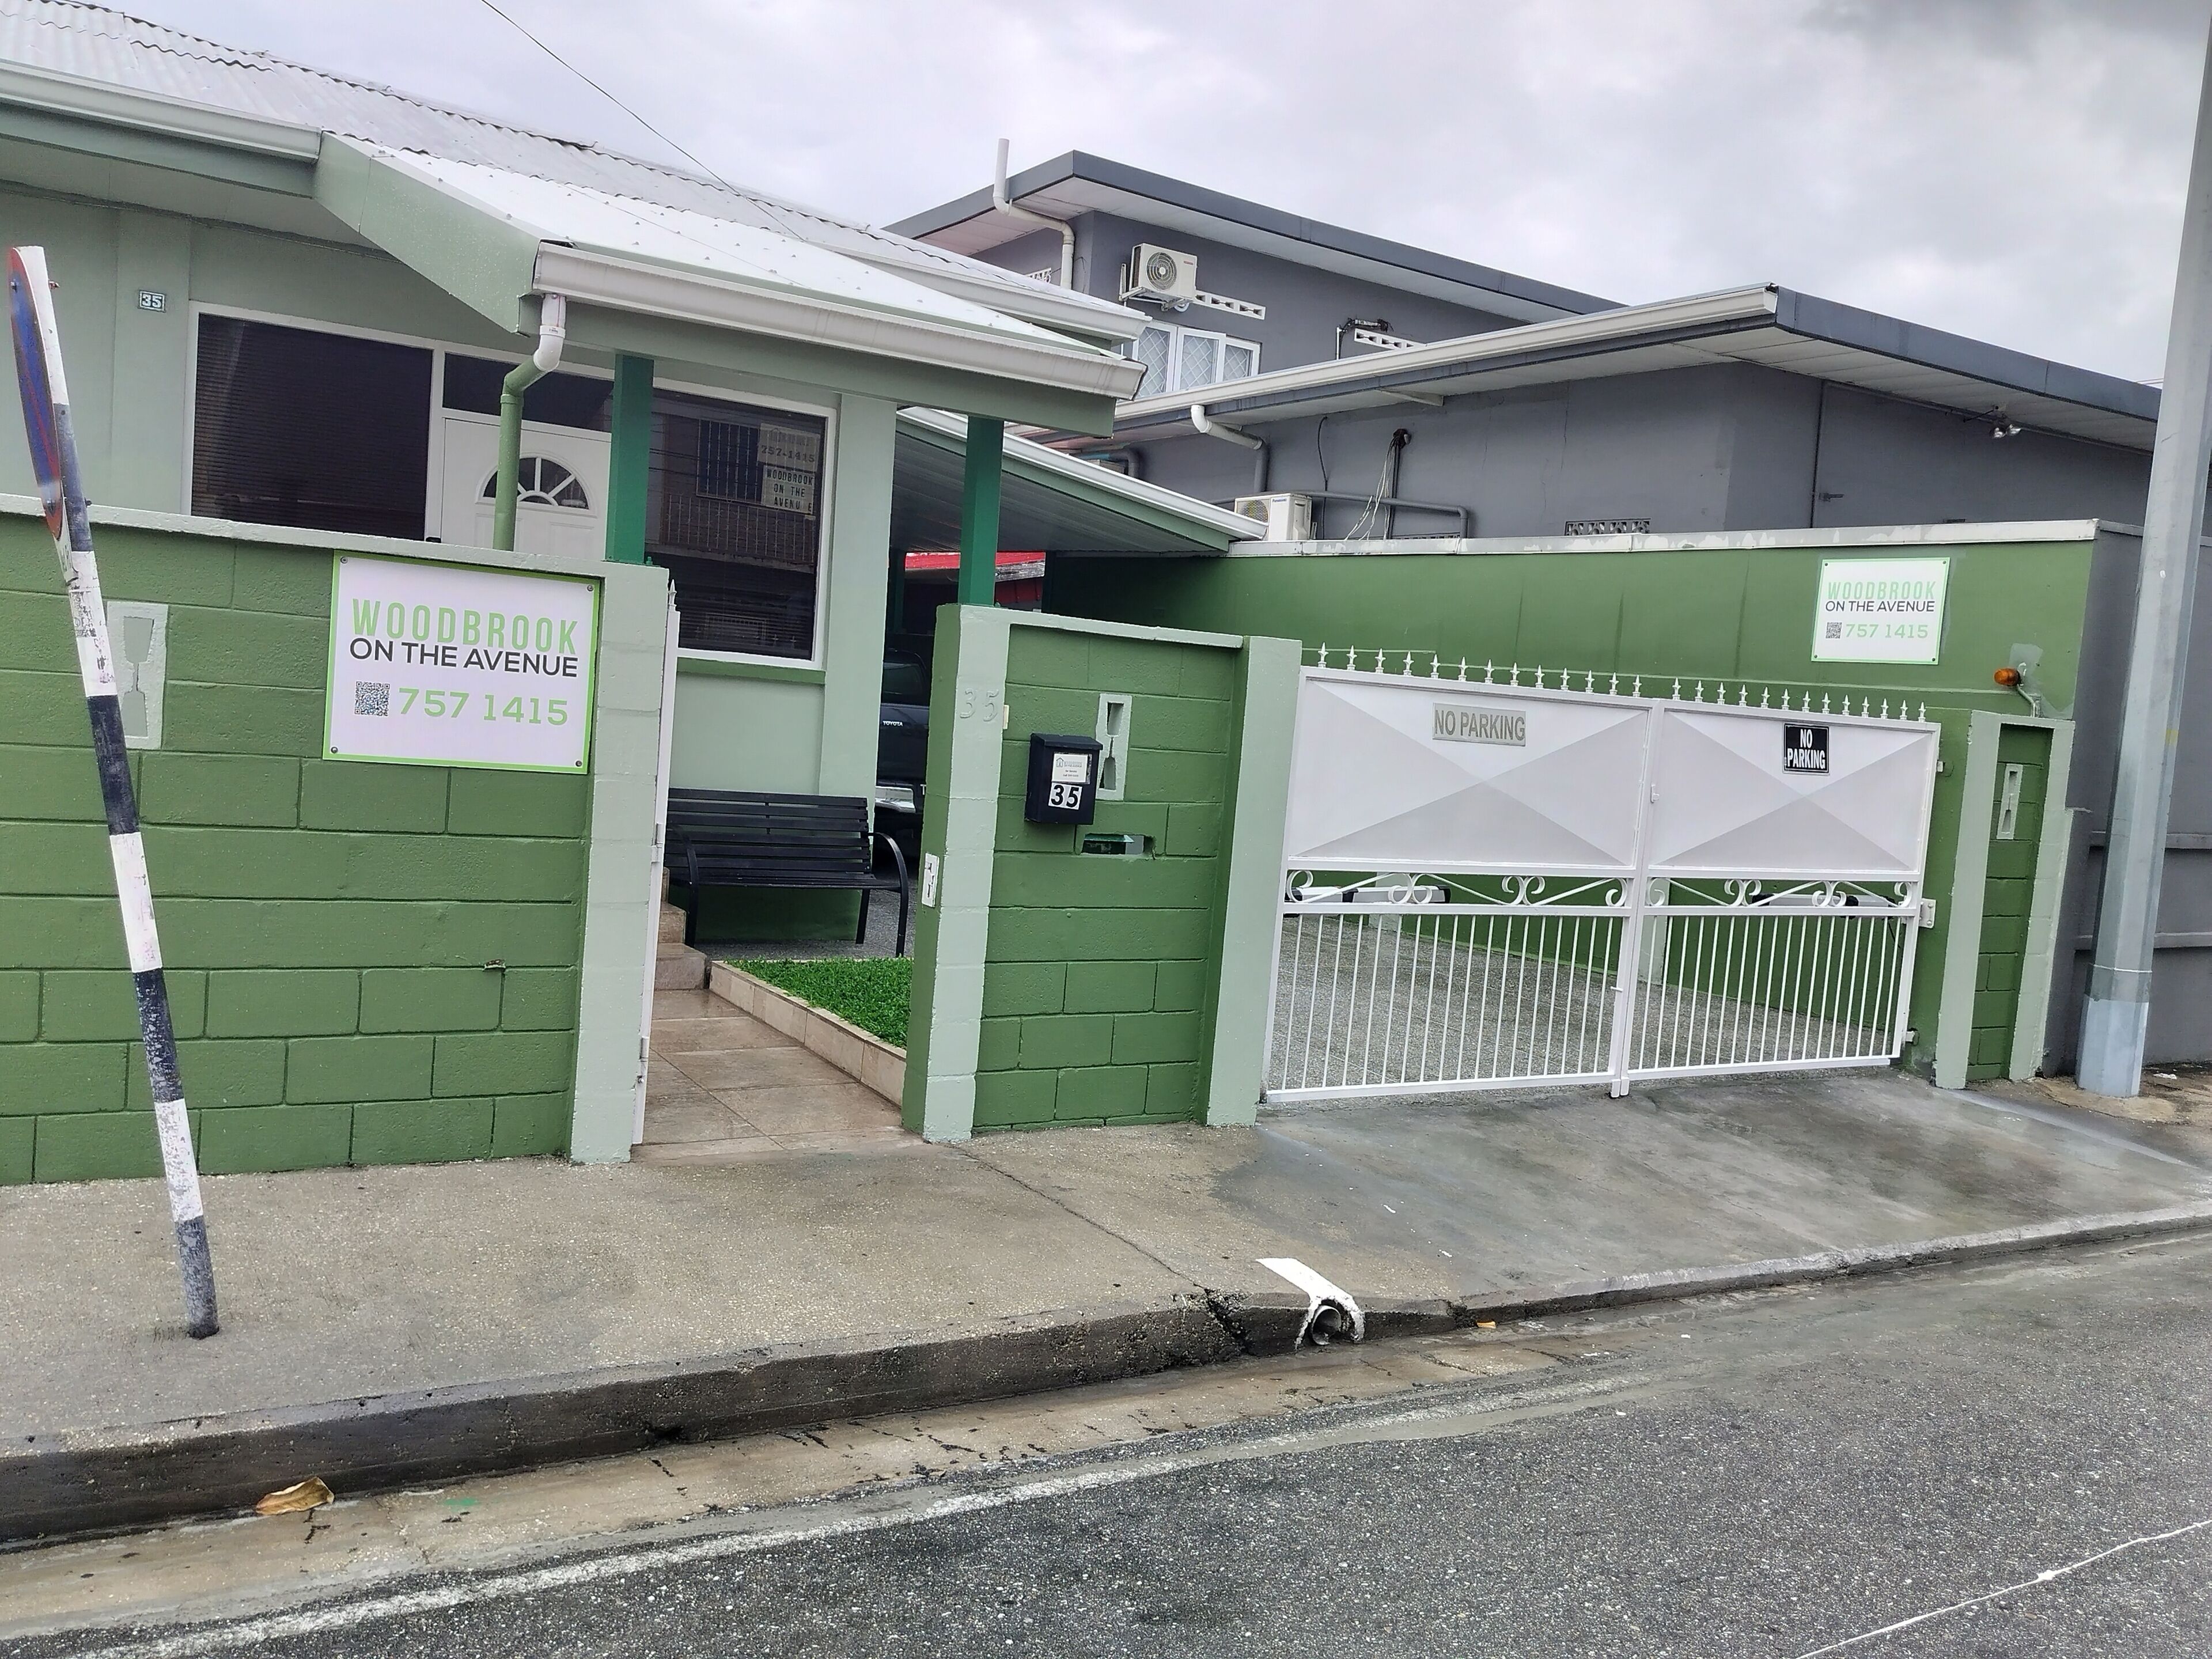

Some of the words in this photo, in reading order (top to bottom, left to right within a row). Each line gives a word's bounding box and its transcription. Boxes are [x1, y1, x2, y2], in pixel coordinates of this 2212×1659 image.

[142, 294, 162, 308] 35
[767, 468, 813, 486] WOODBROOK
[774, 483, 784, 494] ON
[791, 486, 805, 498] THE
[1828, 581, 1936, 600] WOODBROOK
[1825, 601, 1845, 612] ON
[1849, 601, 1874, 612] THE
[1877, 601, 1935, 612] AVENUE
[352, 598, 578, 655] WOODBROOK
[1846, 624, 1878, 638] 757
[1885, 624, 1928, 638] 1415
[350, 637, 394, 663] ON
[401, 641, 459, 668] THE
[463, 648, 578, 677] AVENUE
[399, 687, 469, 719] 757
[483, 694, 569, 726] 1415
[960, 688, 999, 722] 35
[1434, 709, 1456, 736] NO
[1460, 711, 1525, 741] PARKING
[1800, 729, 1813, 748] NO
[1787, 748, 1825, 769] PARKING
[1051, 784, 1080, 808] 35
